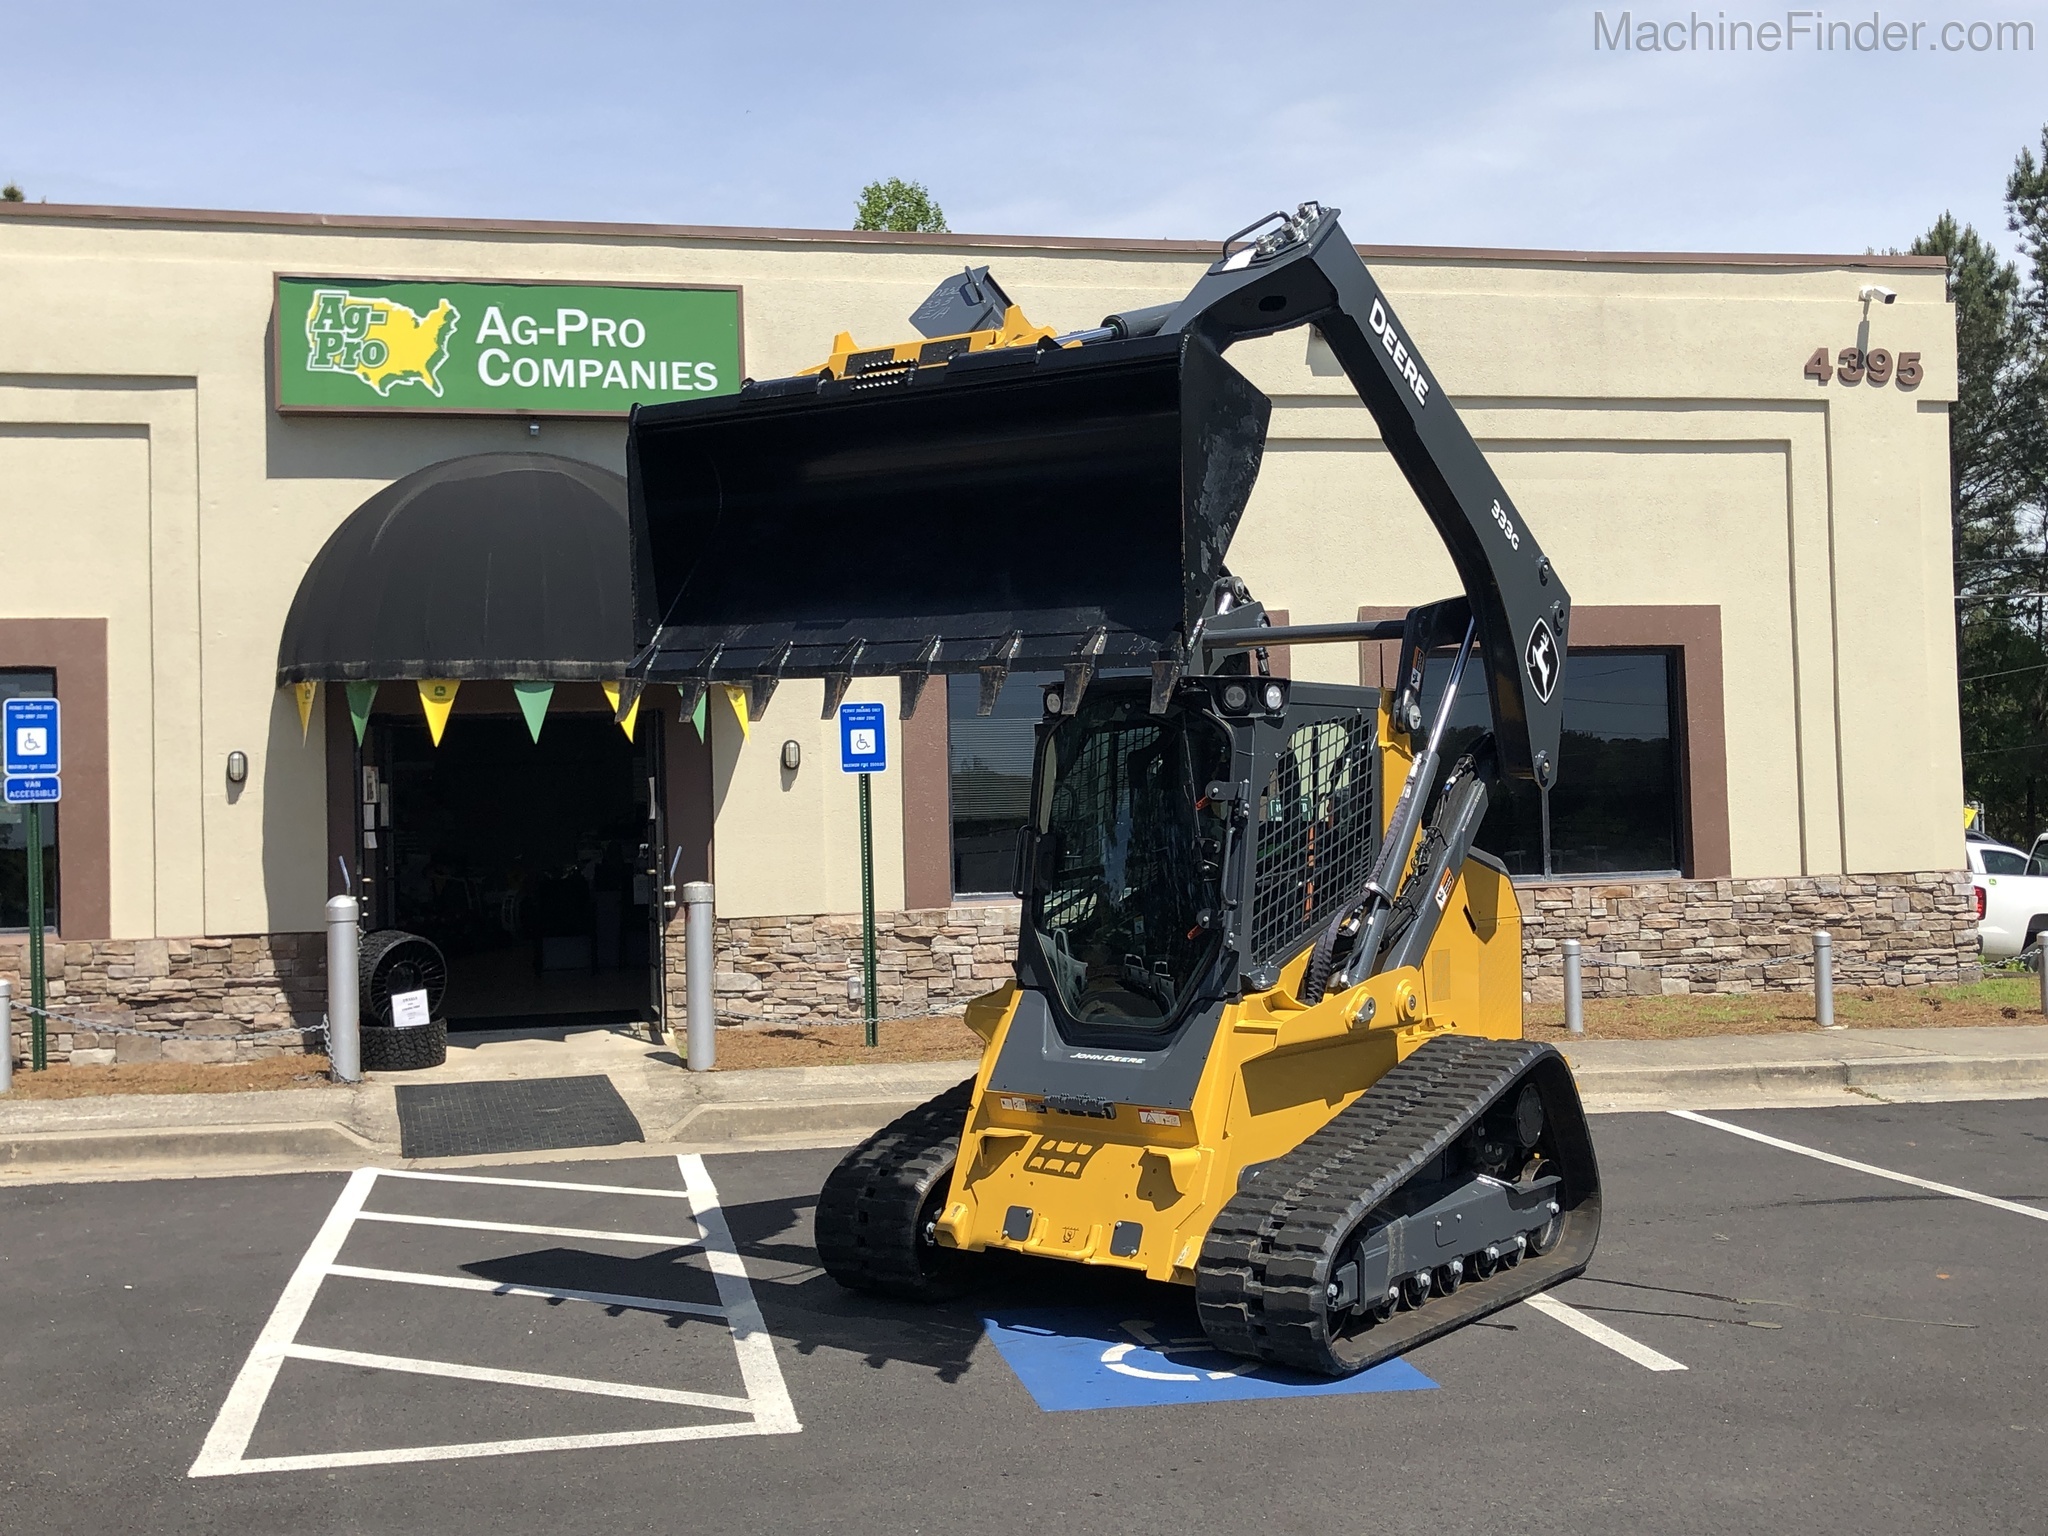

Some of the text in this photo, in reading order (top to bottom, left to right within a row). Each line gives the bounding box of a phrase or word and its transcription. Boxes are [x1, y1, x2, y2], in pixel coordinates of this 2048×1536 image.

[311, 294, 388, 339] Ag-
[311, 331, 389, 368] Pro
[477, 347, 718, 391] COMPANIES
[1368, 297, 1430, 407] DEERE
[1804, 347, 1924, 386] 4395
[1491, 499, 1520, 551] 333G
[9, 789, 57, 798] ACCESSIBLE
[24, 780, 41, 788] VAN
[1070, 1052, 1146, 1064] JOHN DEERE
